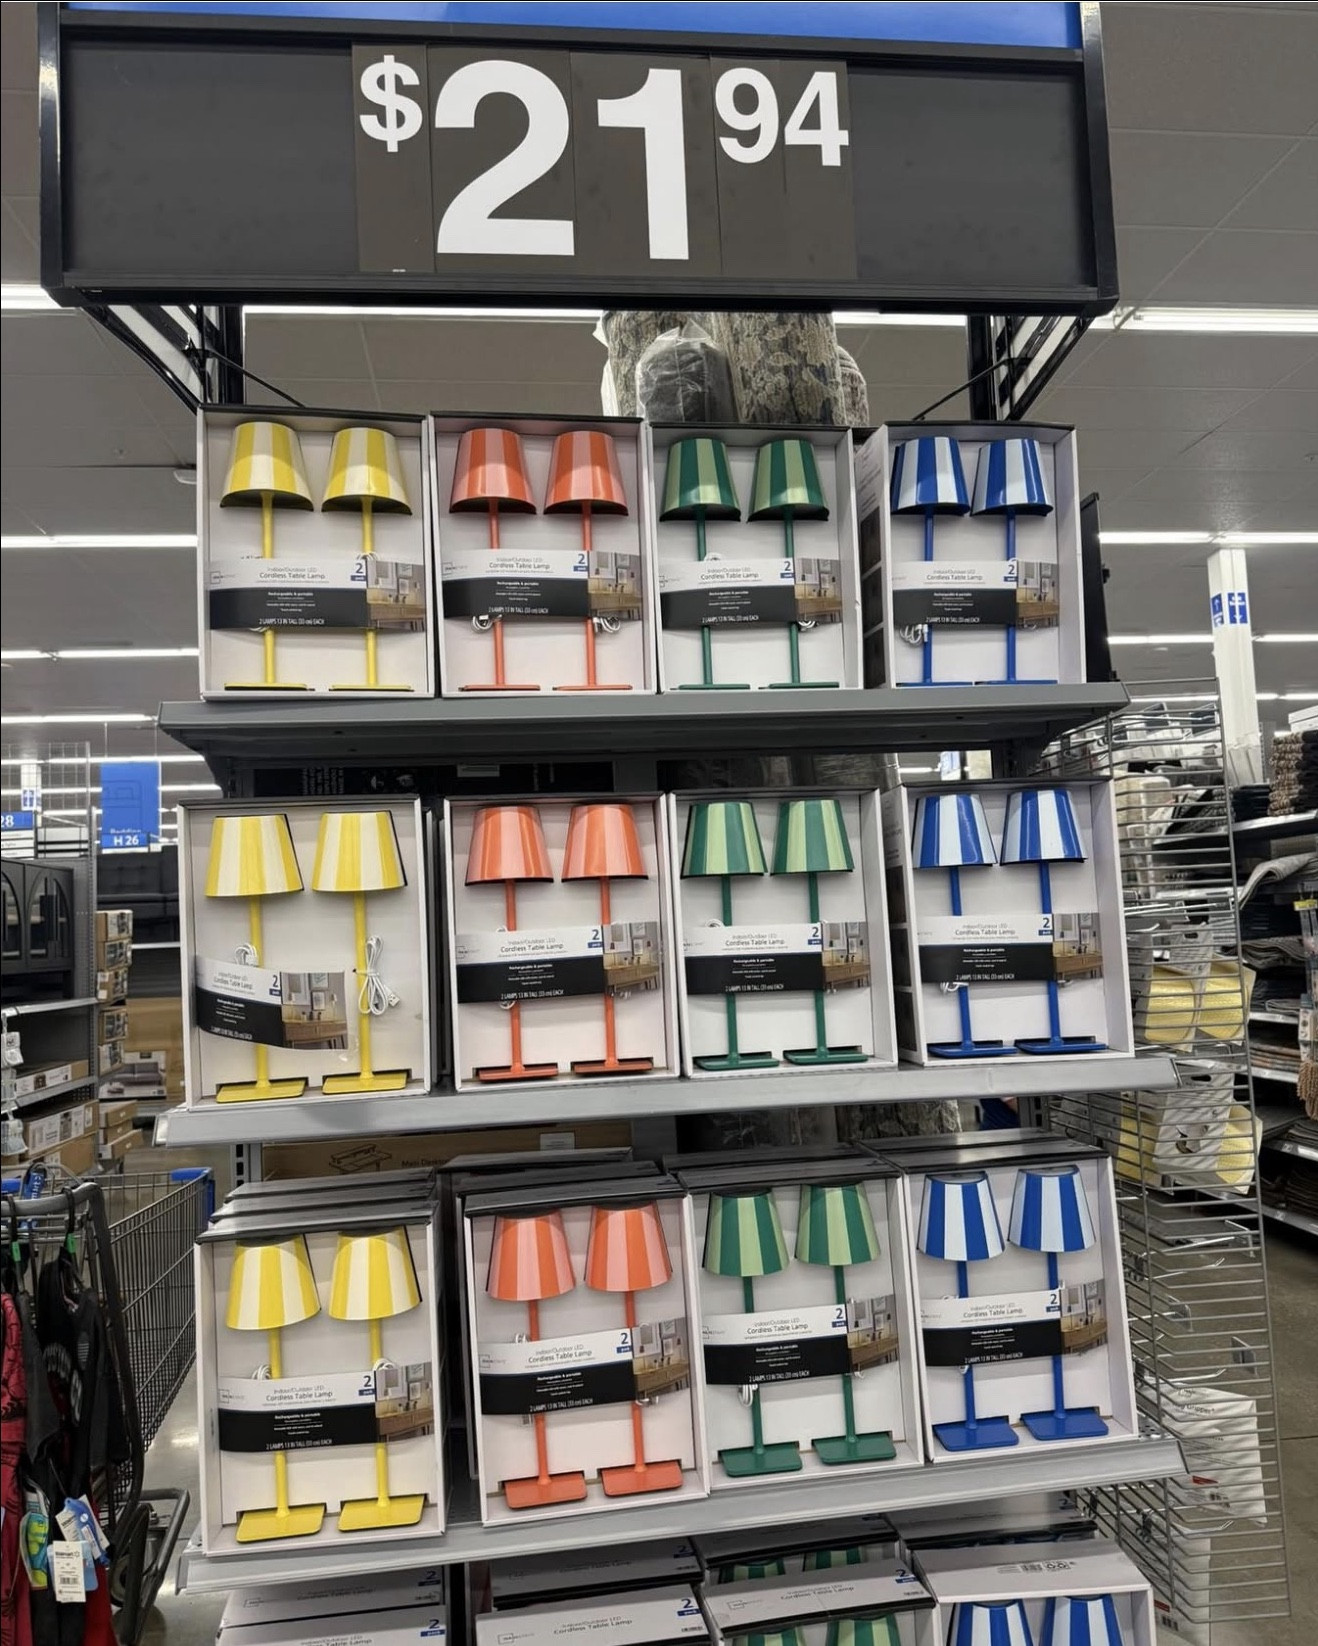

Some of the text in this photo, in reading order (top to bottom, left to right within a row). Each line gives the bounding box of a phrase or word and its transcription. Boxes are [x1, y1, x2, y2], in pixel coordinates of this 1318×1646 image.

[578, 554, 585, 564] 2
[356, 563, 363, 573] 2
[784, 561, 791, 571] 2
[1008, 565, 1015, 574] 2
[114, 835, 139, 846] H 26
[1043, 918, 1050, 928] 2
[592, 930, 599, 940] 2
[812, 927, 819, 937] 2
[273, 976, 278, 987] 2
[1051, 1294, 1057, 1304] 2
[836, 1308, 843, 1319] 2
[621, 1333, 628, 1344] 2
[529, 1354, 554, 1363] Cordless
[364, 1376, 371, 1387] 2
[426, 1571, 436, 1579] 2
[681, 1599, 693, 1608] 2
[429, 1620, 440, 1629] 2
[554, 1626, 585, 1635] Cordless
[611, 1620, 632, 1628] Lamp
